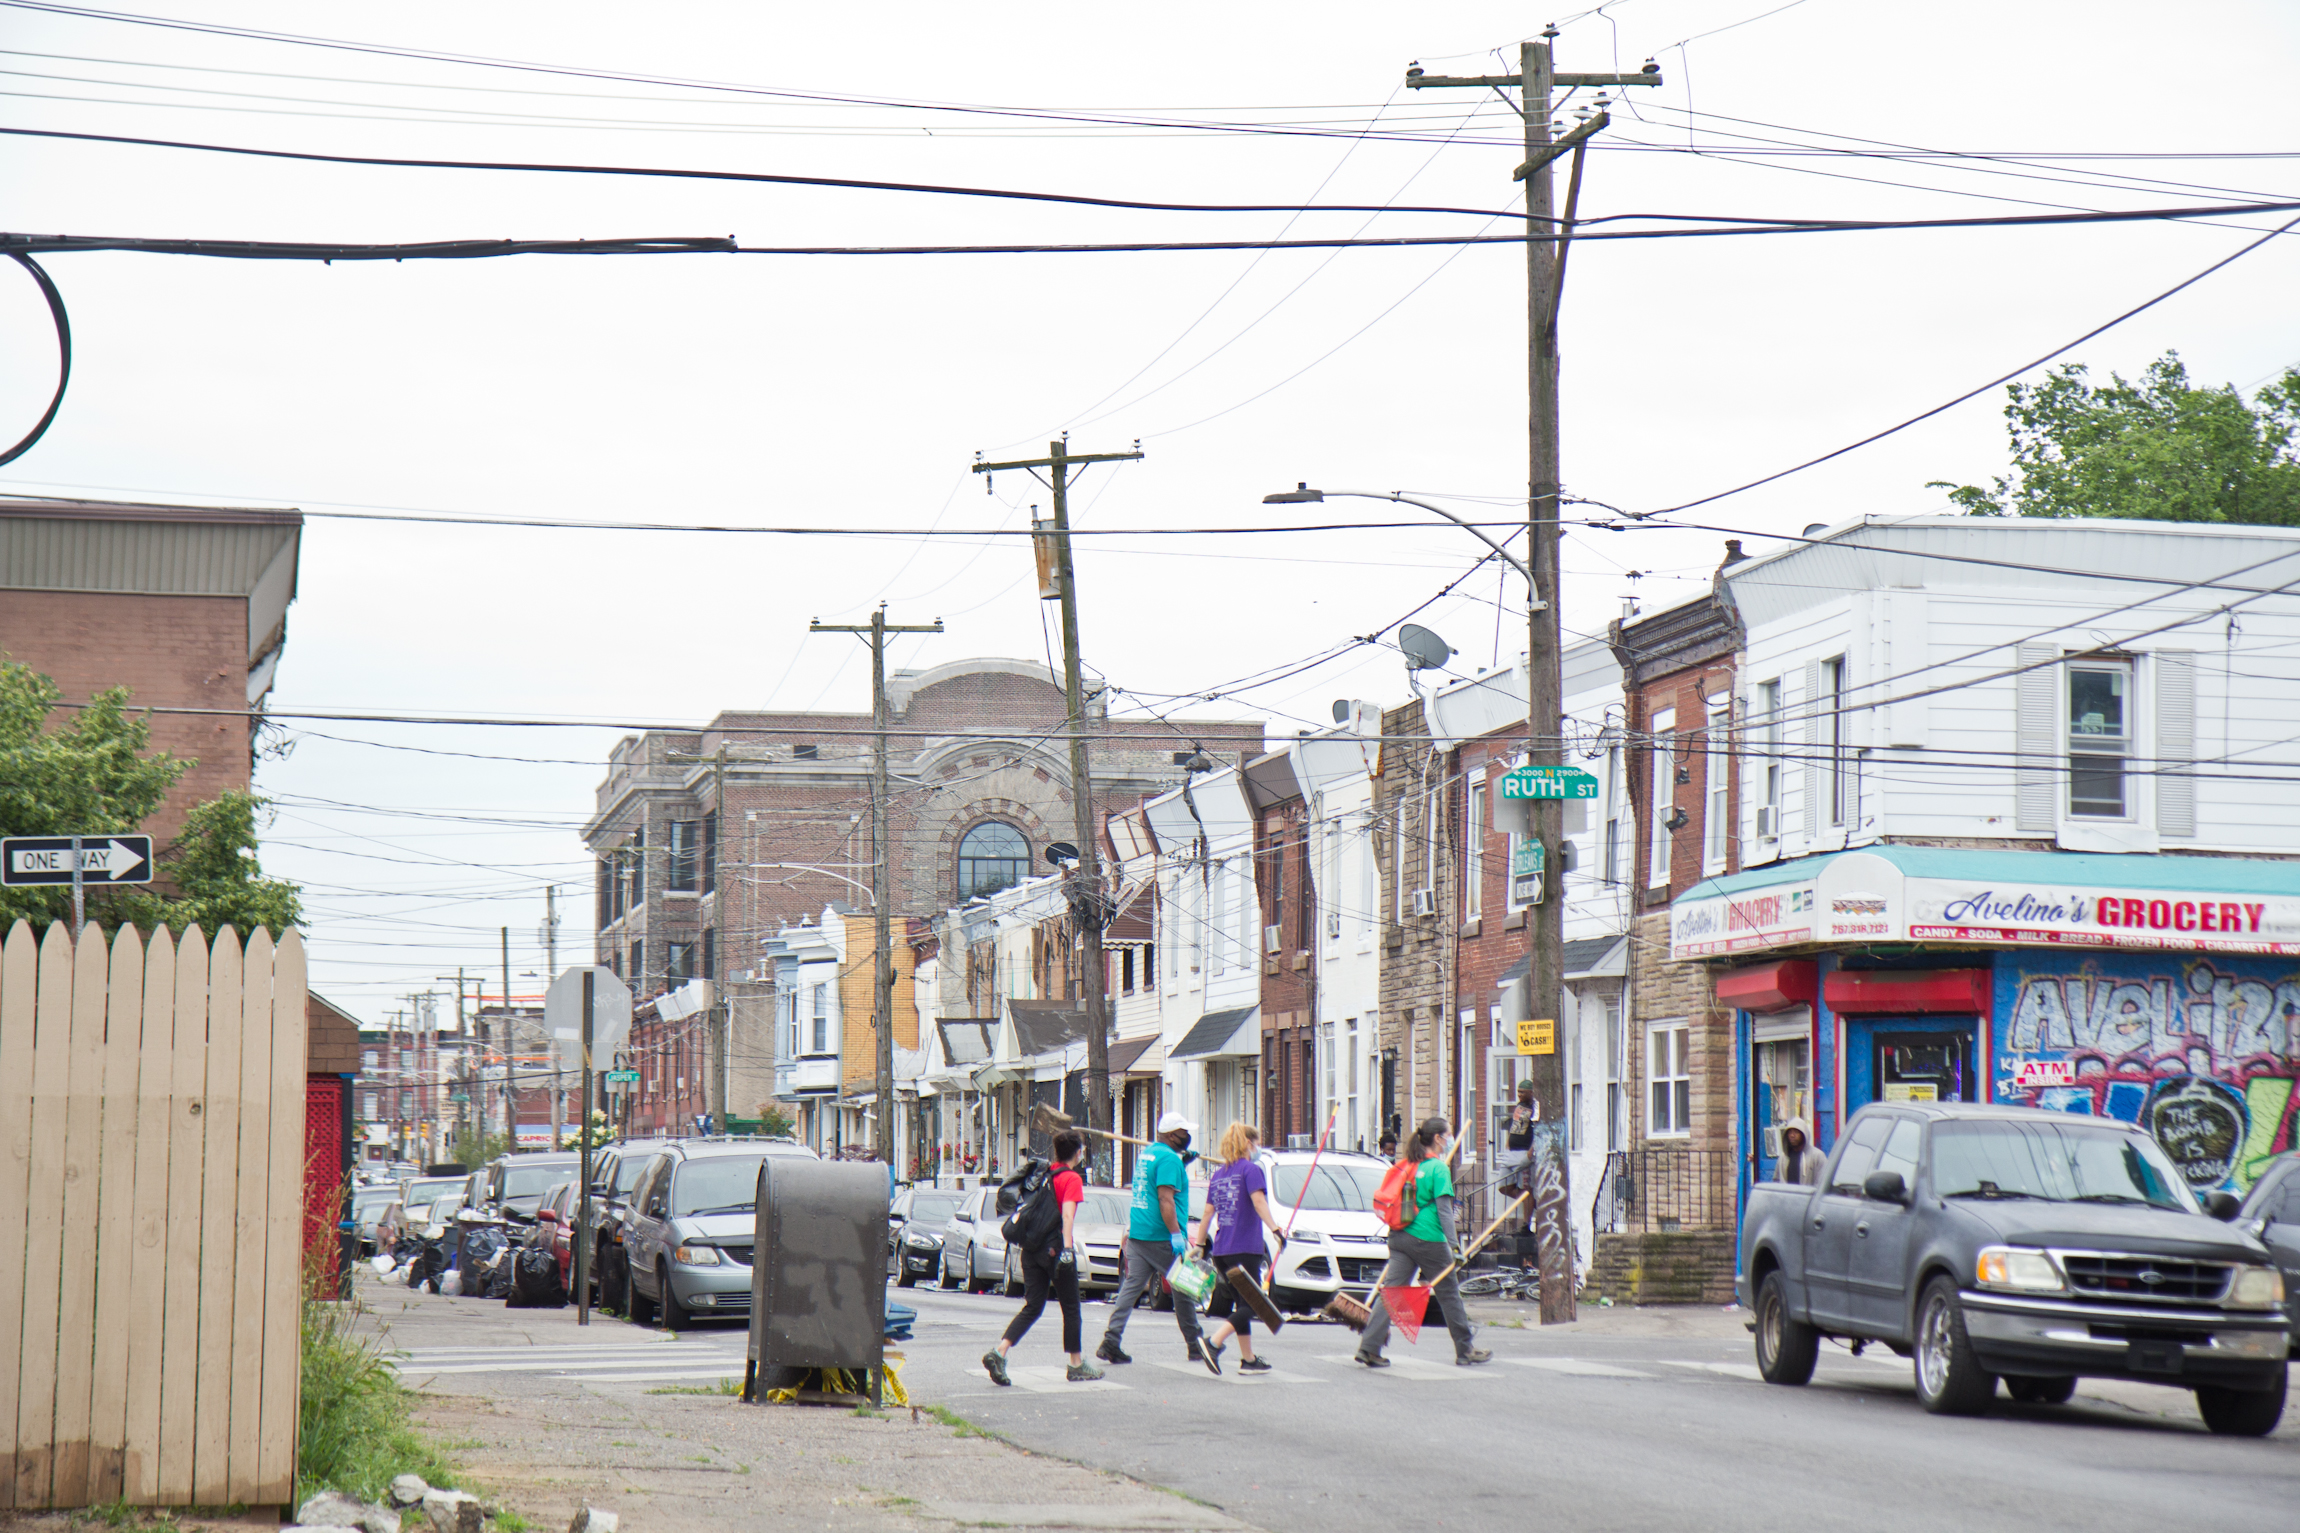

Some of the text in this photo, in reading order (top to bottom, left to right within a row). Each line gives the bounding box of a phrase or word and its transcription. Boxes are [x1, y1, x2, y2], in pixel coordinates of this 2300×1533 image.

[1521, 768, 1579, 778] 3000 N 2900
[1504, 778, 1595, 797] RUTH ST
[24, 852, 60, 869] ONE
[1728, 895, 1780, 932] GROCERY
[1944, 890, 2265, 933] Avelino's GROCERY
[1914, 927, 2300, 955] CANDY SODA MILK BREAD FROZEN FOOD CIGARRETT HO
[609, 1073, 632, 1082] JASPER
[2023, 1062, 2068, 1075] ATM
[2165, 1106, 2200, 1124] THE
[2163, 1119, 2217, 1142] BOMB
[2184, 1141, 2205, 1158] IS
